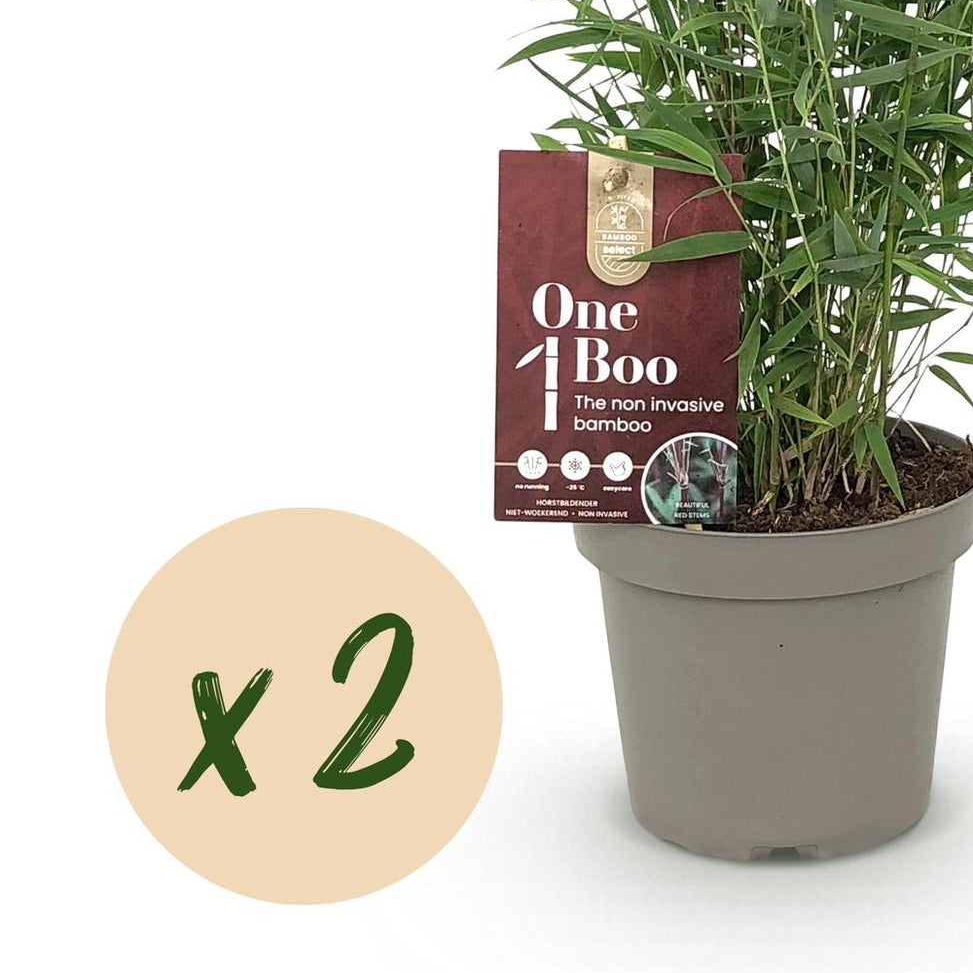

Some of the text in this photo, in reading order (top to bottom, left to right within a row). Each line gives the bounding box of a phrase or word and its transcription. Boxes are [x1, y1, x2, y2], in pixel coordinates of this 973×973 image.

[602, 246, 636, 255] select
[532, 282, 638, 331] One
[573, 336, 678, 385] Boo
[574, 395, 725, 413] The non invasive
[574, 416, 652, 433] bamboo
[524, 484, 550, 492] running
[536, 499, 598, 507] HORSTBILDENDER
